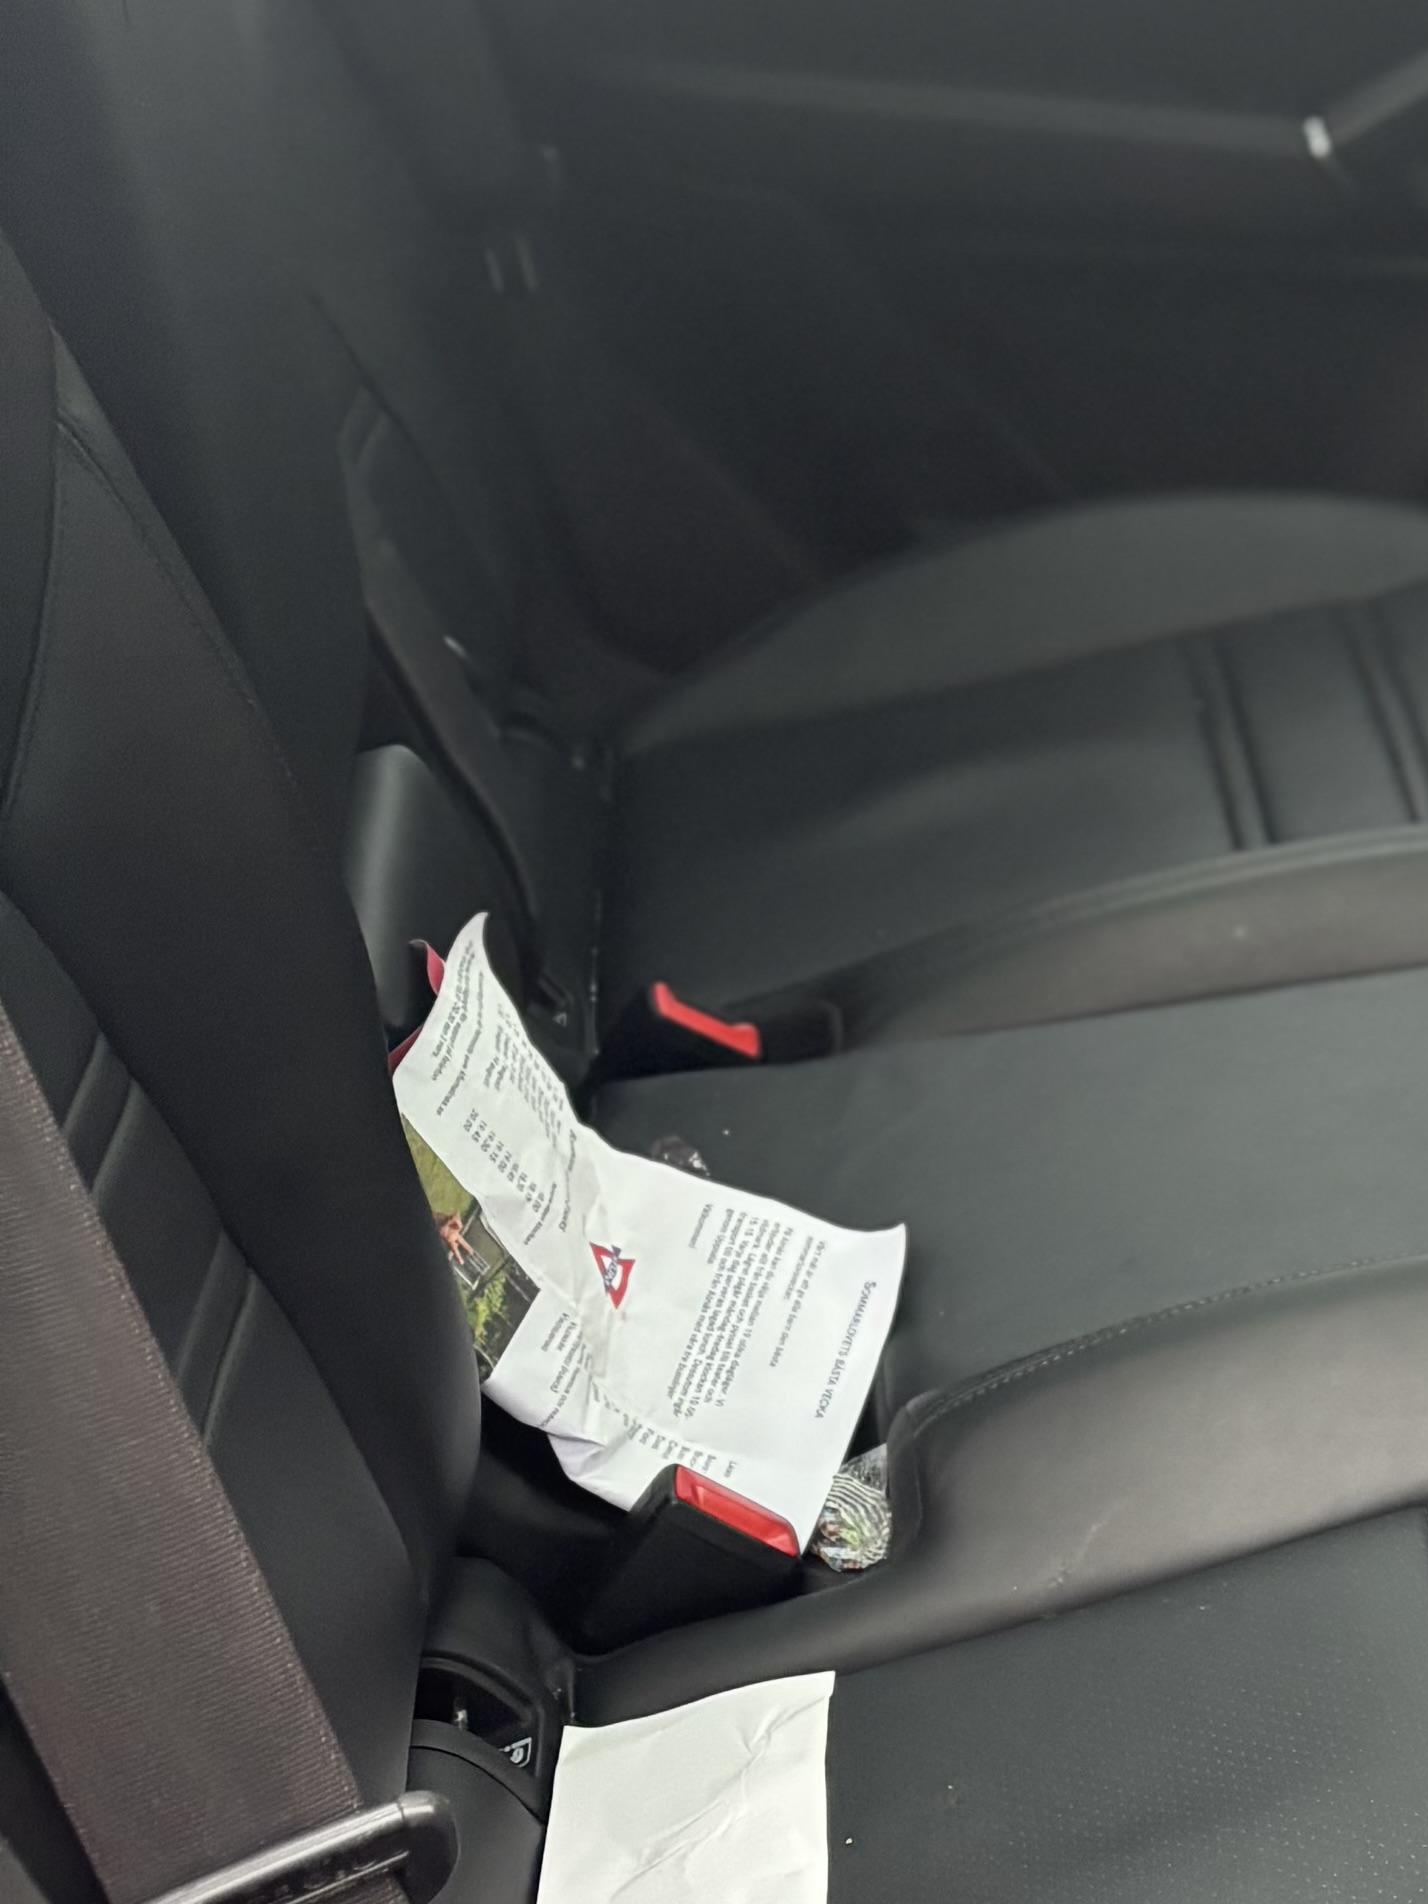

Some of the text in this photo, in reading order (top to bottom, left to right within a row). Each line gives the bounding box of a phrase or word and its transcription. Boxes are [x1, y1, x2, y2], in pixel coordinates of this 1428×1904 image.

[718, 1258, 727, 1271] och
[727, 1259, 740, 1273] dag
[771, 1256, 781, 1269] kan
[711, 1273, 723, 1289] från
[753, 1266, 764, 1281] från
[715, 1275, 733, 1308] serveras
[733, 1276, 745, 1299] pågår
[706, 1309, 721, 1332] lagad
[736, 1309, 745, 1323] och
[748, 1300, 762, 1326] mellan
[694, 1315, 706, 1333] med
[724, 1324, 739, 1349] pyssel
[720, 1351, 731, 1362] till
[734, 1339, 747, 1358] olika
[711, 1364, 725, 1387] teater
[704, 1388, 715, 1403] och
